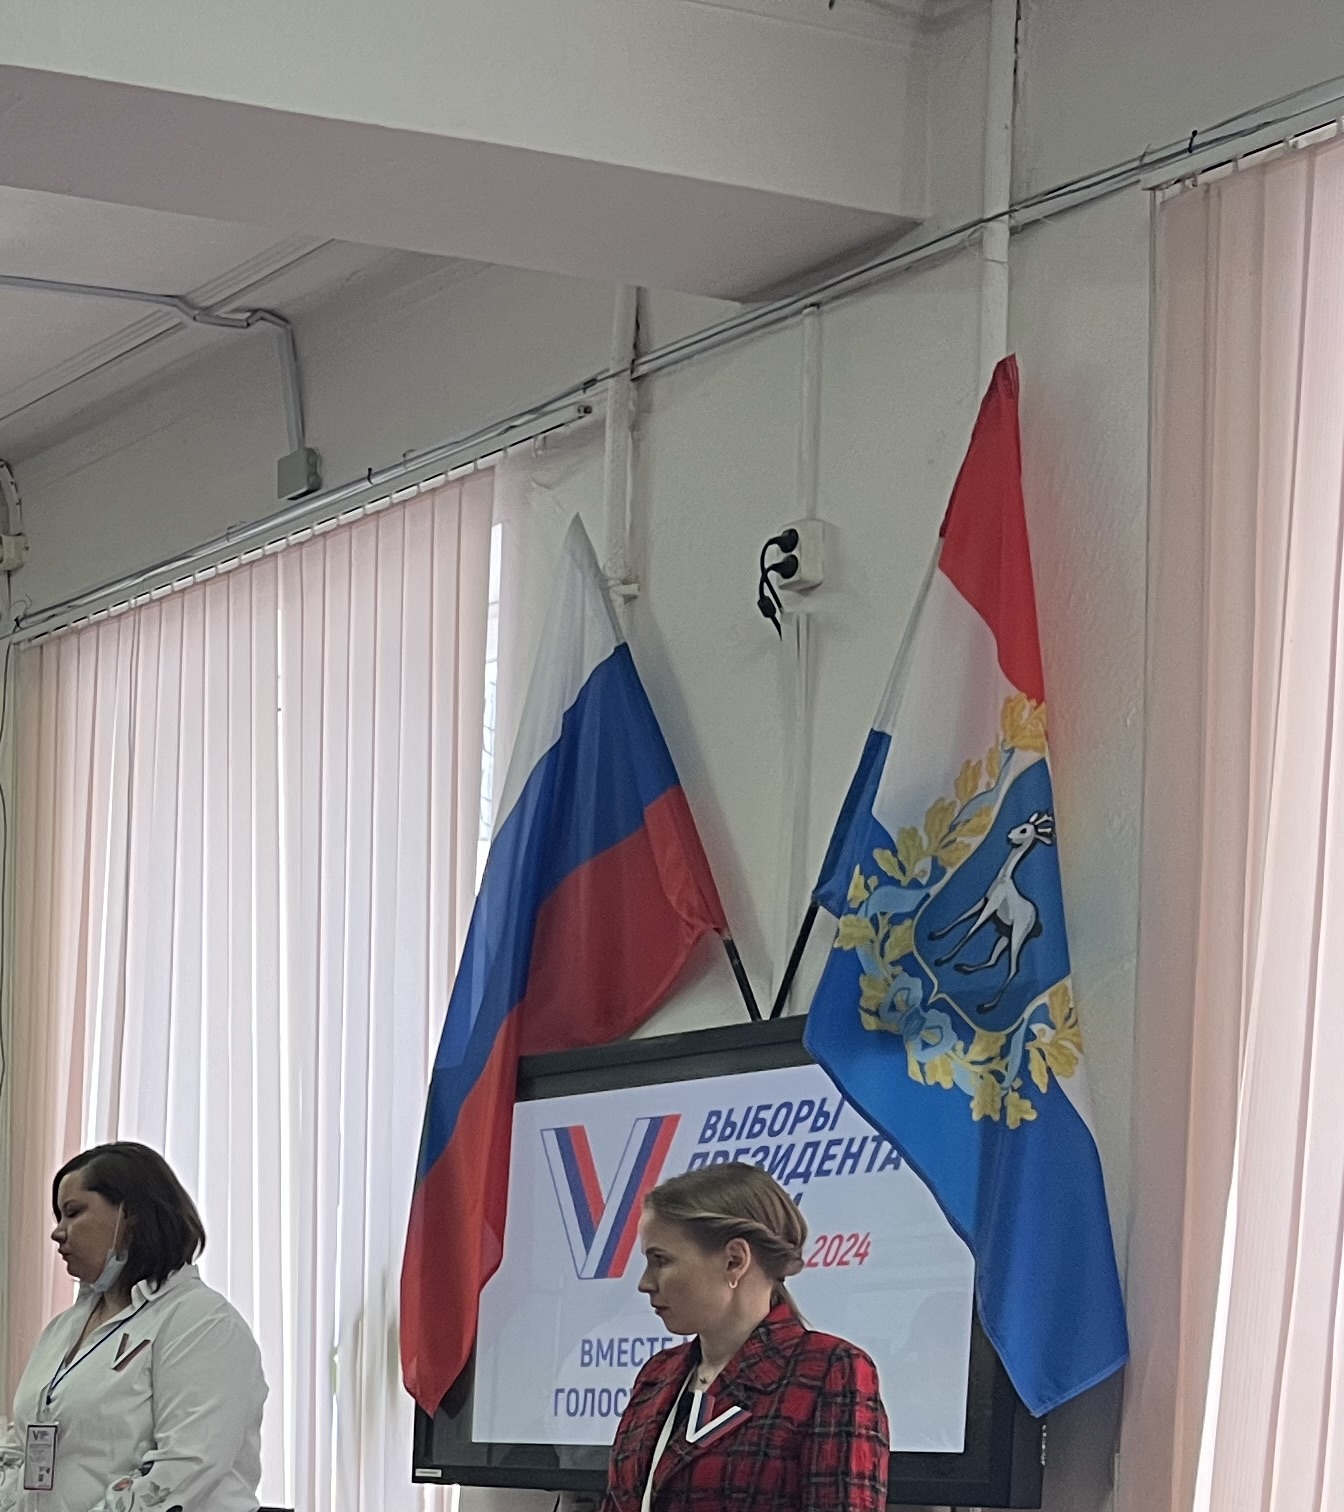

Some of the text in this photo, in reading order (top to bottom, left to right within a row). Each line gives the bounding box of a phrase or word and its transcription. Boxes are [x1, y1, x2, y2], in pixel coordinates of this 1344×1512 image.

[698, 1097, 845, 1145] ВЫБОРЫ
[805, 1232, 871, 1268] 2024
[553, 1387, 633, 1418] ГОЛОС
